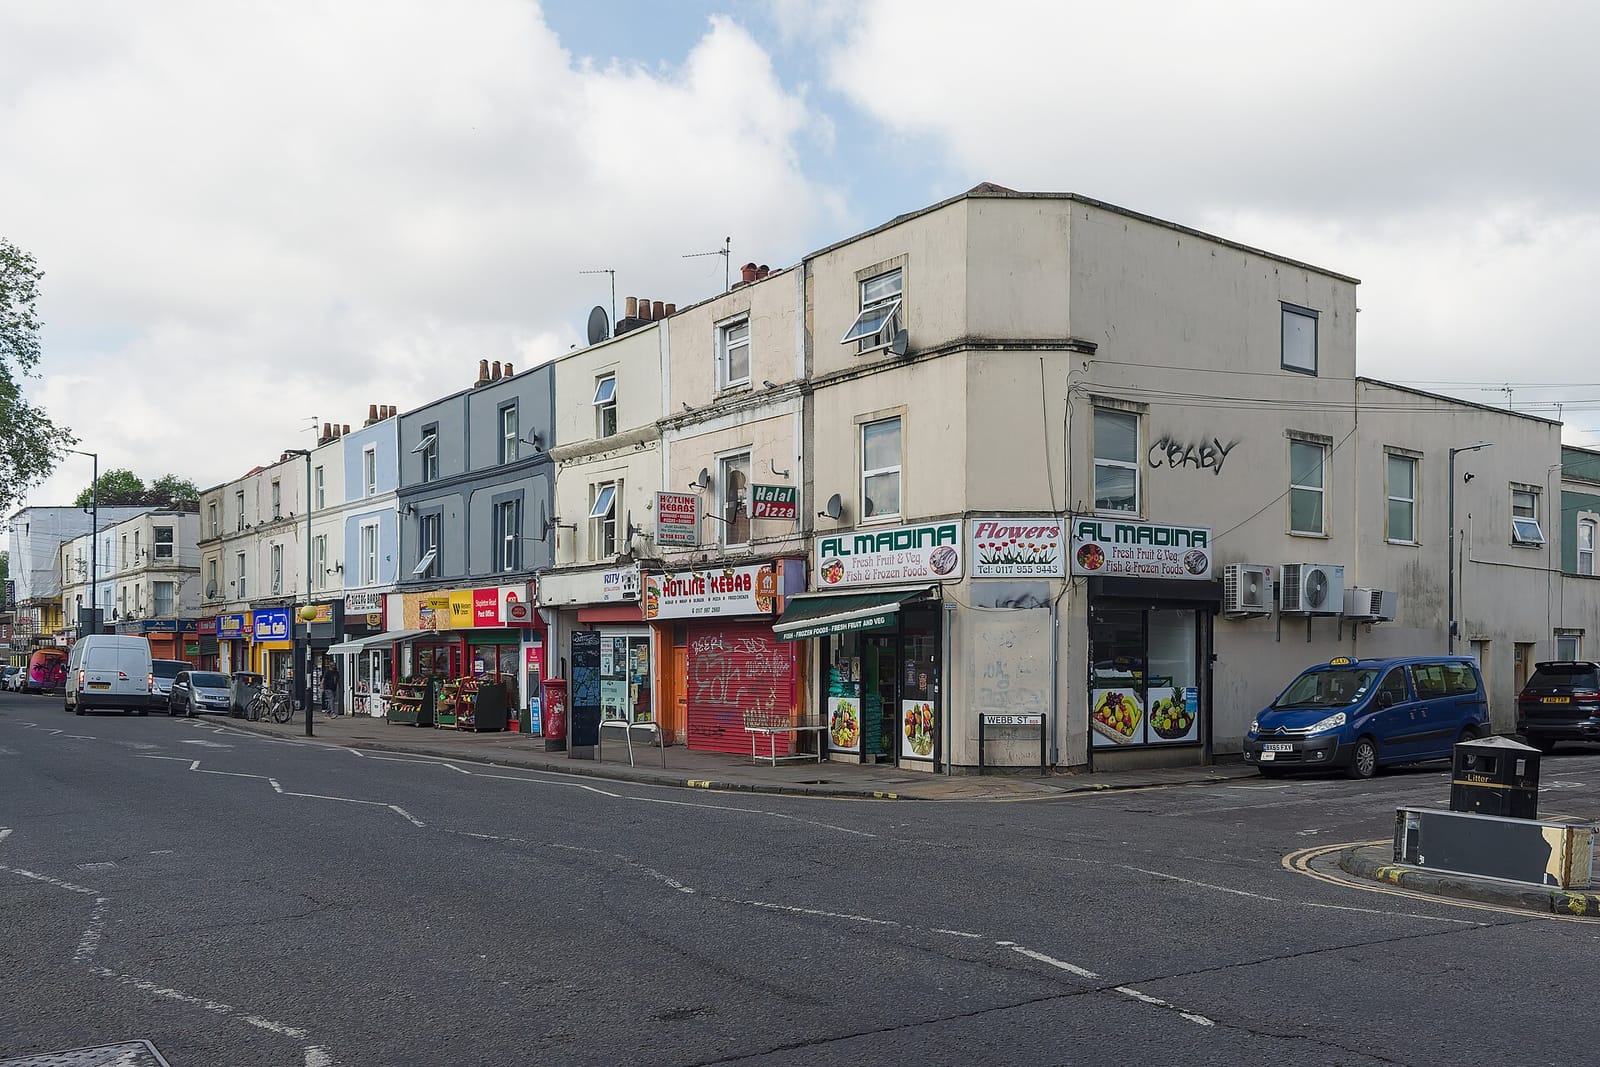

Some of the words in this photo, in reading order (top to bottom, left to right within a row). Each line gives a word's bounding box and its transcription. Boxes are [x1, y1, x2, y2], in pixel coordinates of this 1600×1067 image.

[756, 487, 792, 502] Halal
[660, 503, 695, 512] KEBABS
[755, 502, 794, 518] Pizza
[975, 522, 1060, 539] Flowers
[1079, 521, 1111, 542] AL
[1115, 524, 1207, 548] MADINA
[821, 538, 851, 558] AL
[854, 524, 956, 555] MADINA
[852, 555, 873, 568] Fresh
[876, 554, 896, 566] Fruit
[897, 553, 904, 564] &
[1112, 546, 1134, 559] Fresh
[1137, 547, 1154, 560] Fruit
[1157, 548, 1163, 560] &
[846, 570, 862, 582] Fish
[864, 569, 871, 580] &
[873, 567, 900, 581] Frozen
[902, 566, 928, 578] Foods
[977, 565, 993, 574] Tel:
[995, 565, 1013, 574] 0117
[1016, 565, 1033, 574] 955
[1036, 565, 1058, 574] 9443
[1106, 560, 1122, 572] Fish
[1125, 561, 1132, 573] &
[1133, 561, 1159, 574] Frozen
[1161, 563, 1183, 575] Foods
[663, 577, 705, 597] HOTLINE
[711, 573, 752, 594] KEBAB
[783, 632, 794, 640] FISH
[795, 629, 813, 638] FROZEN
[813, 627, 829, 636] FOODS
[848, 621, 862, 629] FRUIT
[874, 616, 885, 624] VEG
[987, 716, 1013, 724] WEBB
[1017, 716, 1028, 724] ST
[1467, 773, 1489, 783] Litter
